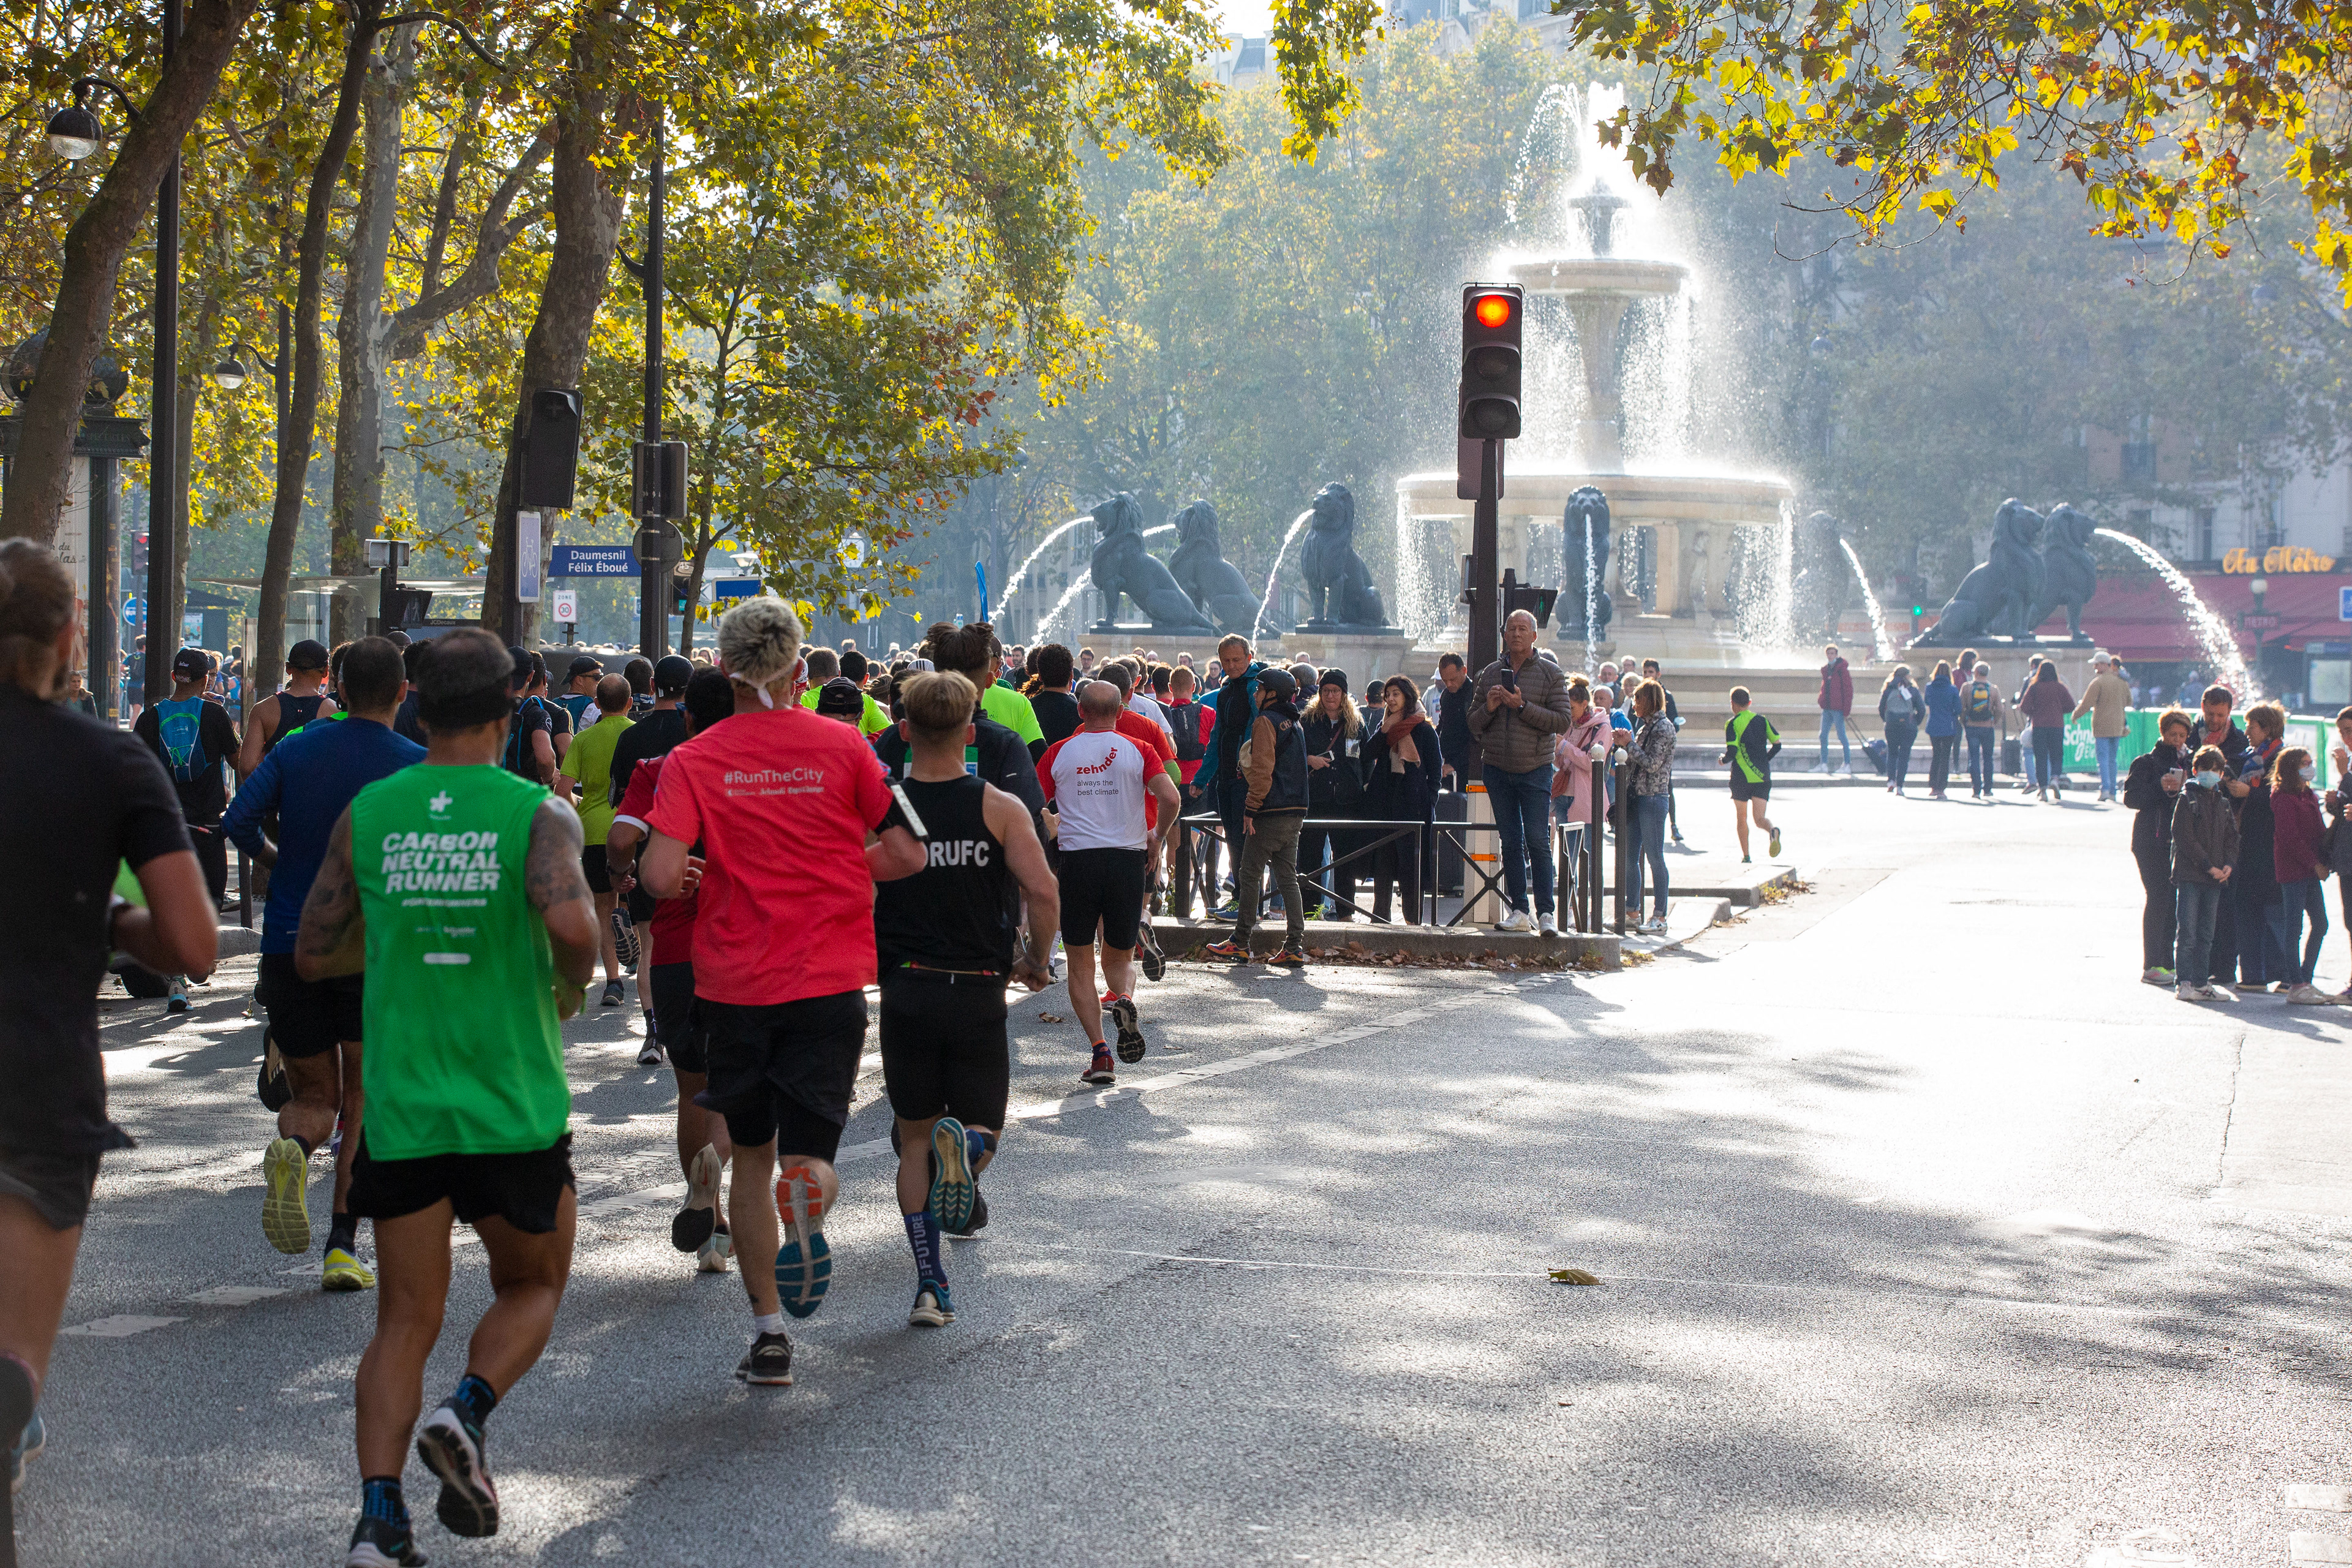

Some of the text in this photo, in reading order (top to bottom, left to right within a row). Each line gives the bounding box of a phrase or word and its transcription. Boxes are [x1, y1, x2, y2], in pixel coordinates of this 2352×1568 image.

[571, 550, 626, 560] Daumesnil
[568, 561, 628, 573] Félix Éboué
[1076, 747, 1118, 774] zehnder
[724, 767, 824, 785] #RunTheCity
[382, 831, 499, 853] CARBON
[380, 851, 501, 874] NEUTRAL
[924, 840, 989, 867] RUFC
[385, 871, 501, 894] RUNNER
